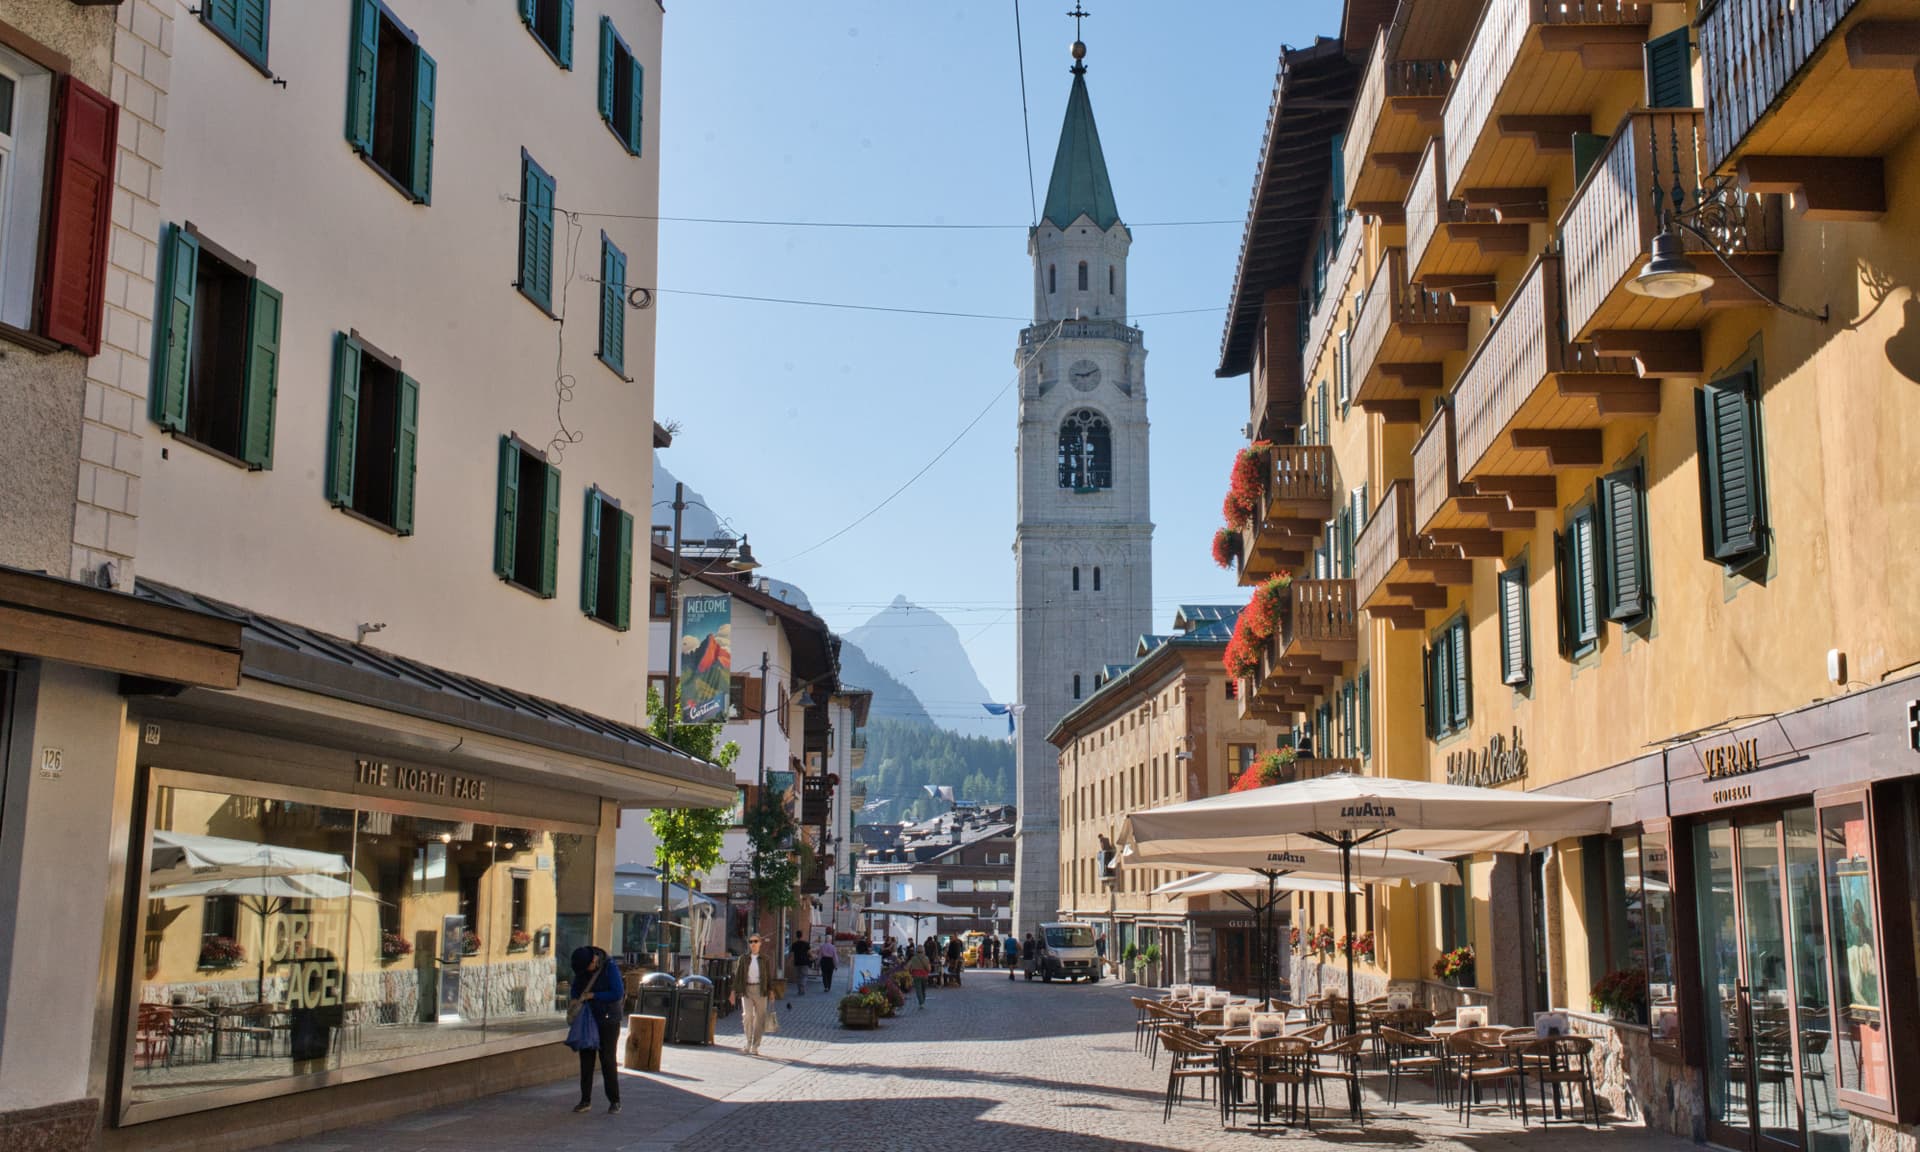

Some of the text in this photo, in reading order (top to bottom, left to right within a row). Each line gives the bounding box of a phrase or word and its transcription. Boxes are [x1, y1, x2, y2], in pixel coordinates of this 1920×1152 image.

[687, 599, 728, 613] WELCOME
[44, 749, 61, 769] 126
[1703, 737, 1758, 780] VERNI
[357, 759, 487, 801] THE NORTH FACE
[1712, 783, 1752, 804] GIOIELLI
[1341, 802, 1396, 817] LAVAZZA
[1267, 851, 1306, 864] LAVAZZA
[1228, 920, 1261, 928] GUES
